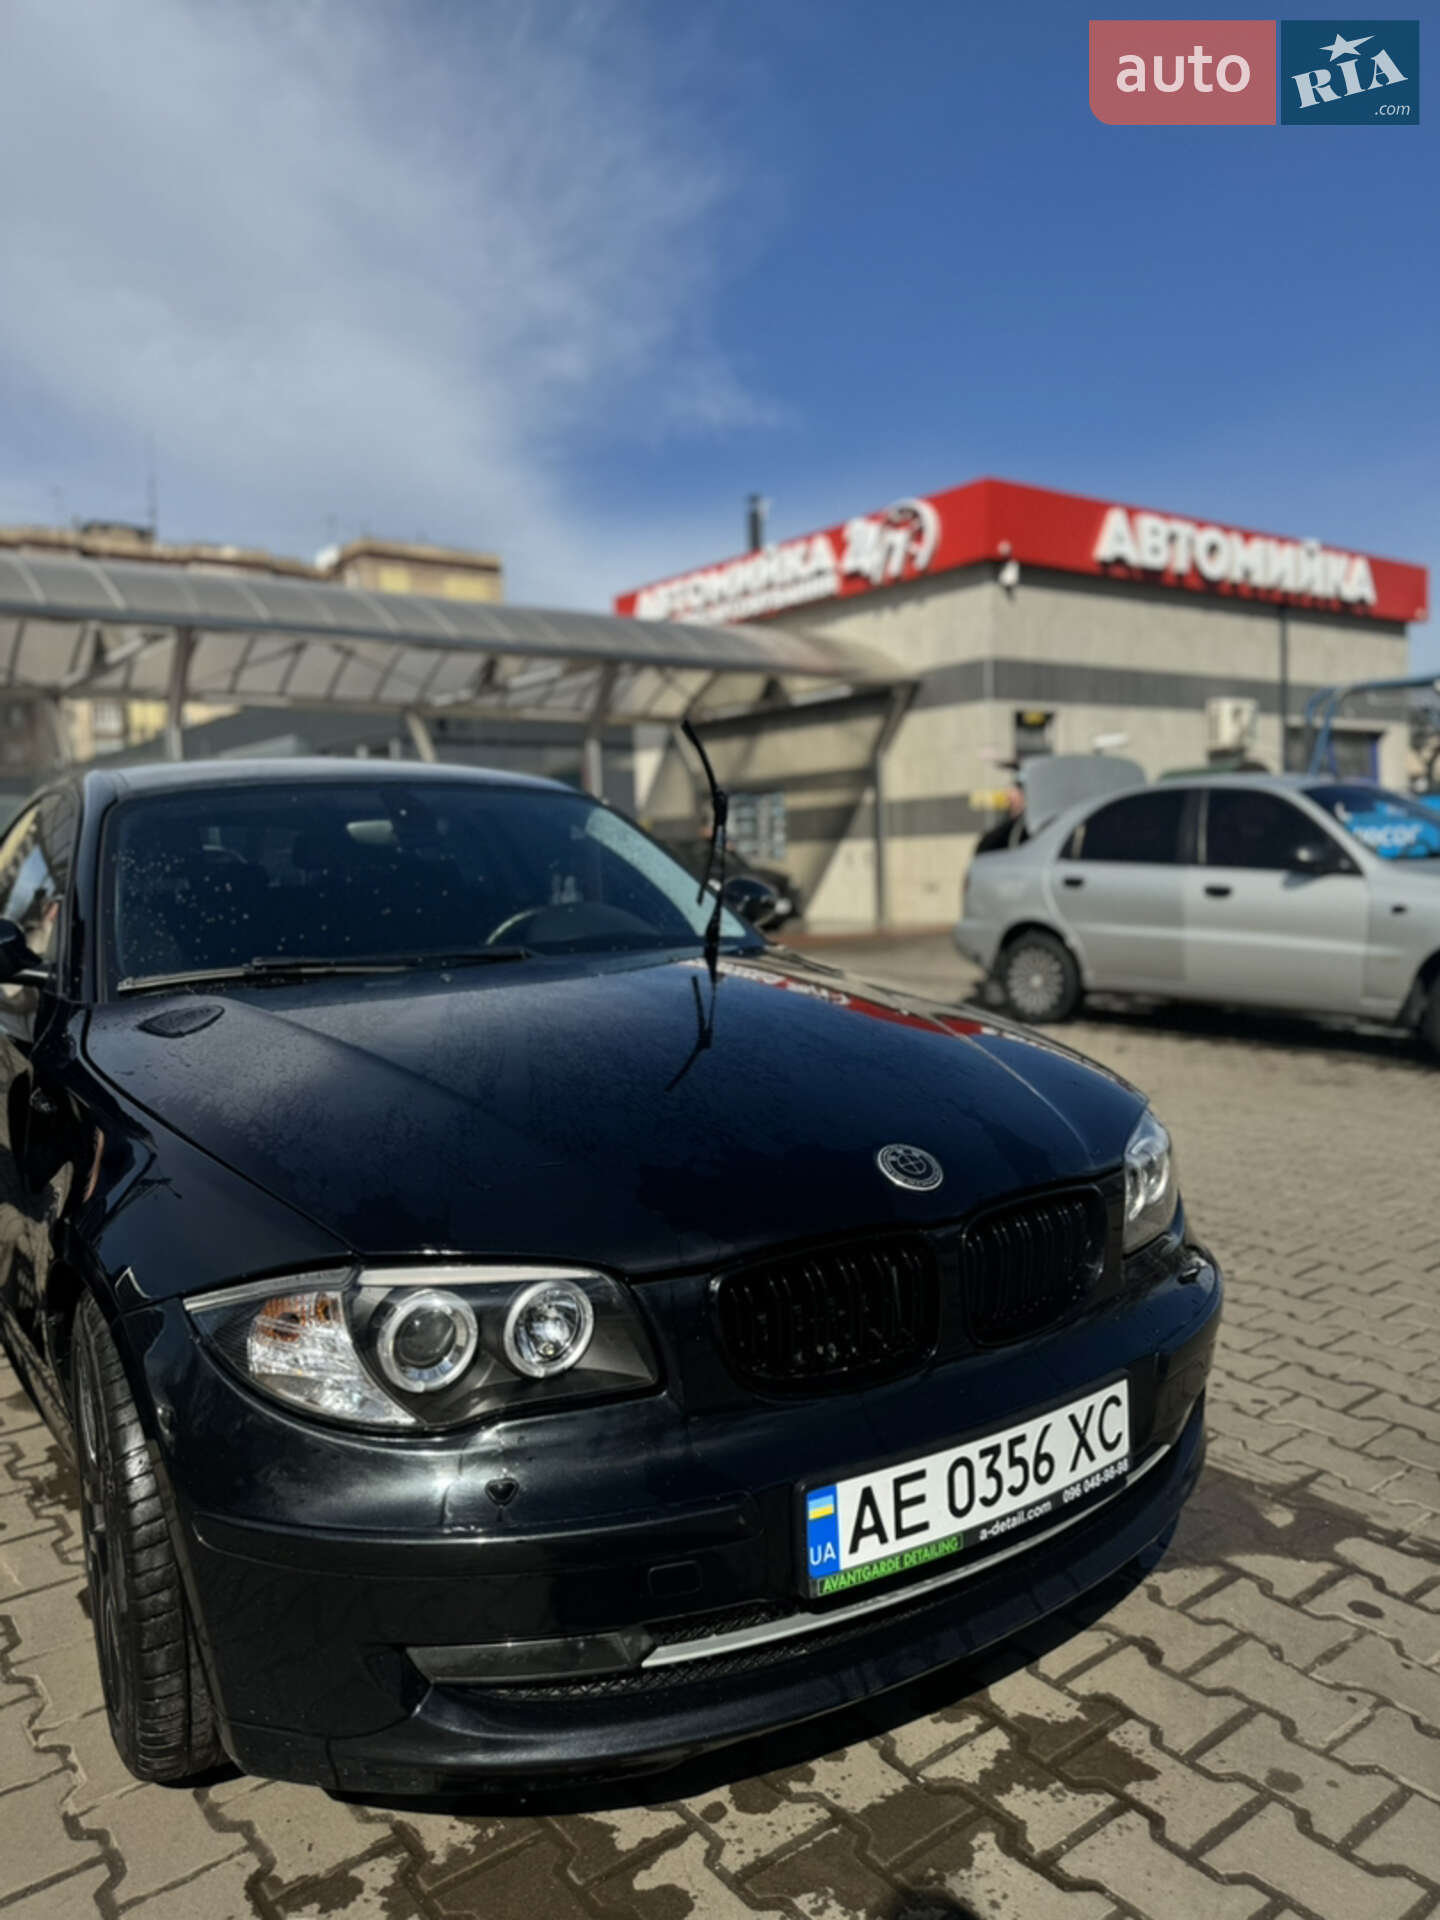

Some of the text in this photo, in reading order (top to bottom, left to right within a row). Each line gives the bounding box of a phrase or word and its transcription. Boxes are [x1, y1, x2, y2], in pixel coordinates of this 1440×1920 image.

[1093, 506, 1377, 606] АВТОМИЙКА
[849, 1395, 1123, 1555] AE 0356 XC
[979, 1501, 1052, 1540] a-detail.com
[809, 1541, 837, 1566] UA
[822, 1536, 959, 1592] AVANTGARDE DETAILING
